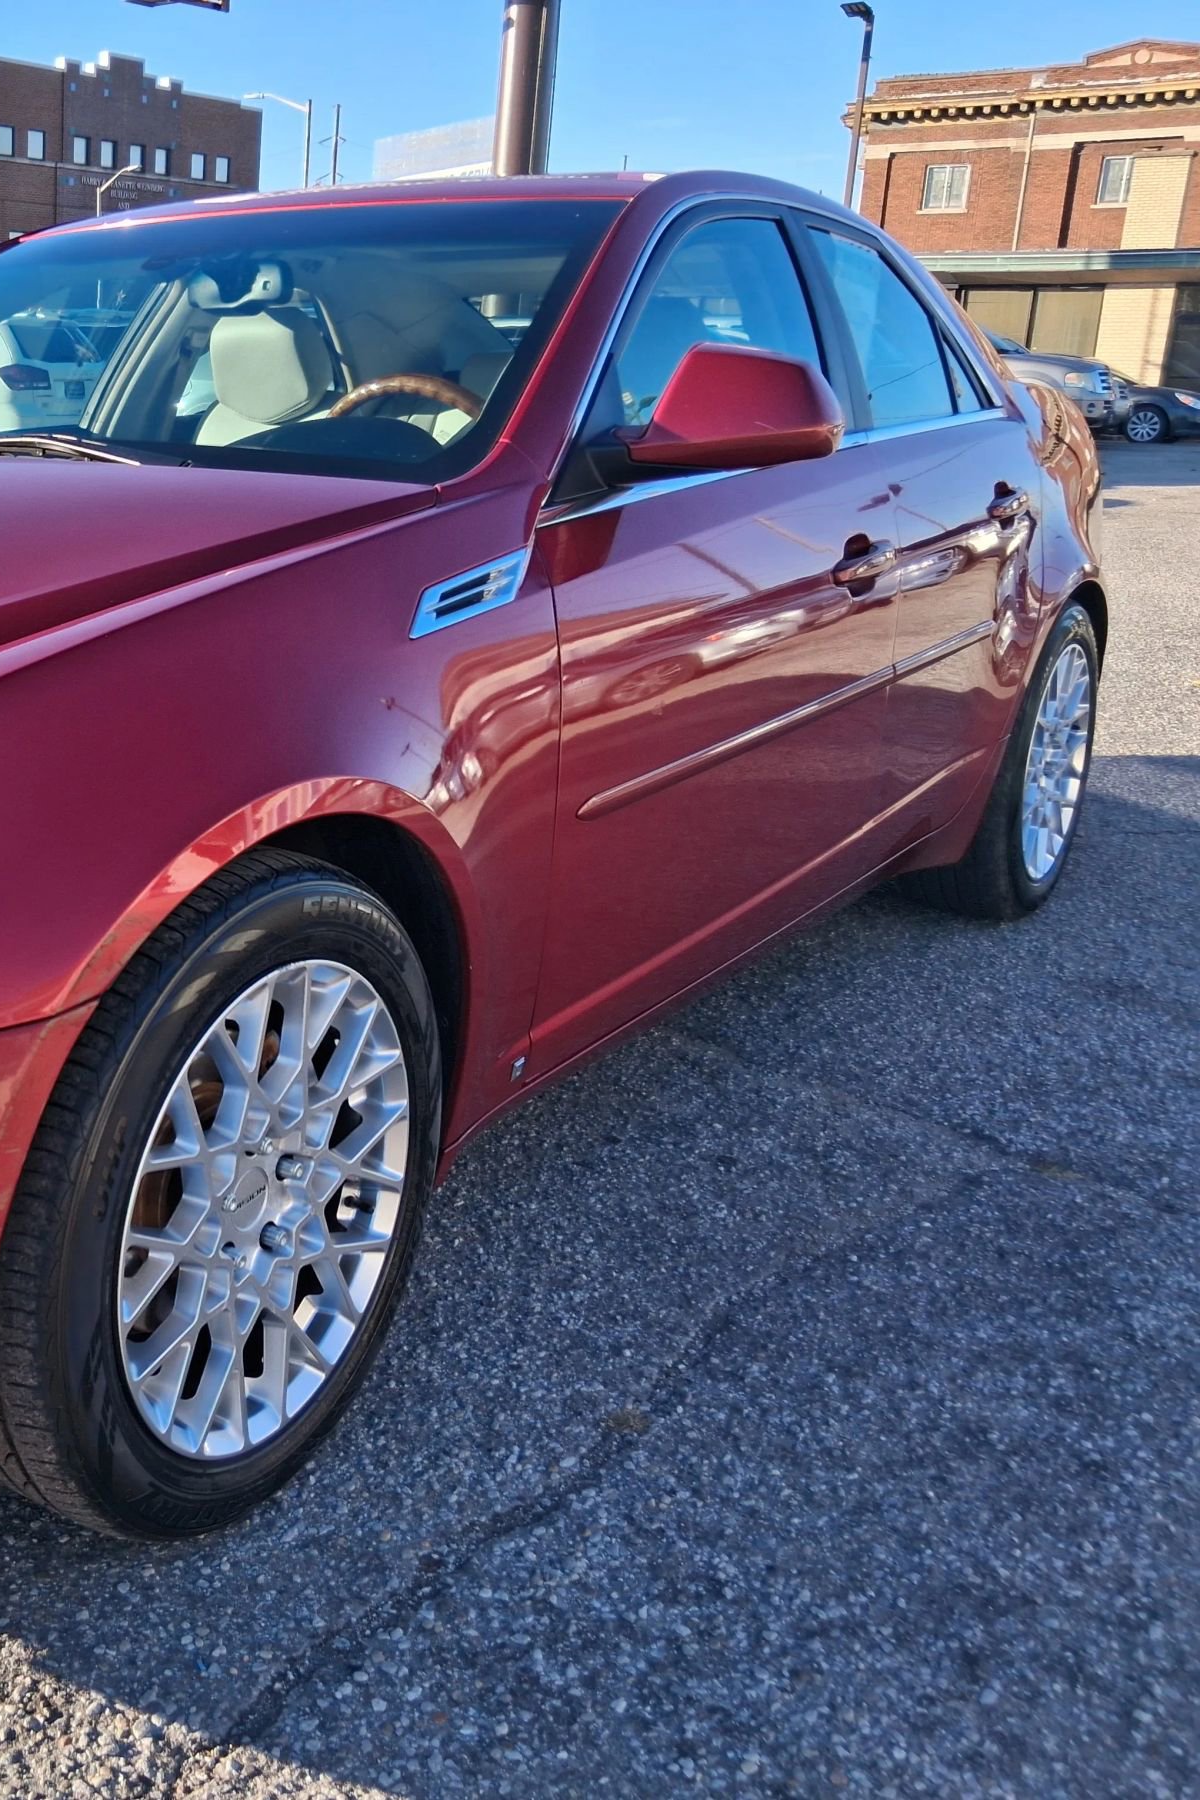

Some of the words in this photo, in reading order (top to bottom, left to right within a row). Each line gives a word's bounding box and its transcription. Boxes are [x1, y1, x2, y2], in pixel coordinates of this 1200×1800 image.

[81, 176, 101, 187] HARRY
[110, 189, 138, 200] BUILDING
[117, 201, 130, 210] AND
